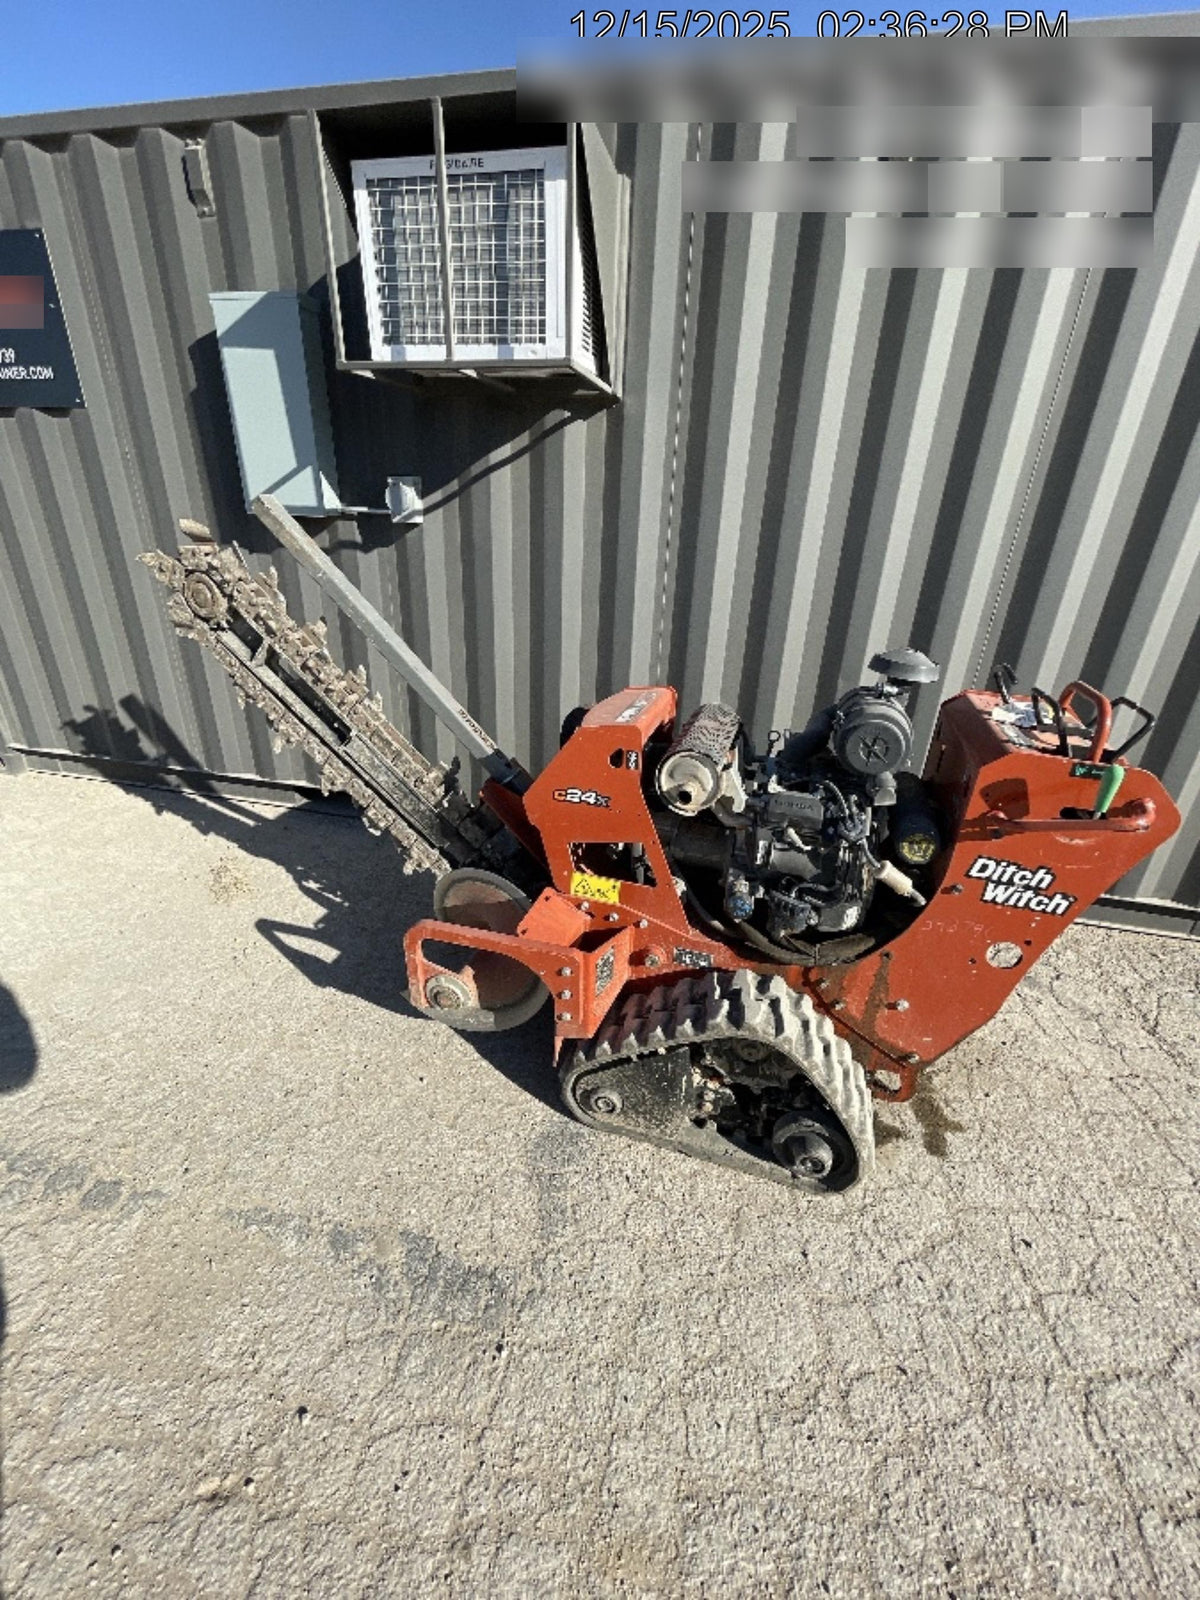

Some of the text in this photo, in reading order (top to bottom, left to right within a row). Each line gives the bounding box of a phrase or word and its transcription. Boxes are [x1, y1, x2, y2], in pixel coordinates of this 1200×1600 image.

[430, 157, 484, 170] FGIDAIRE
[966, 856, 1055, 890] Ditch
[981, 881, 1073, 916] Witch
